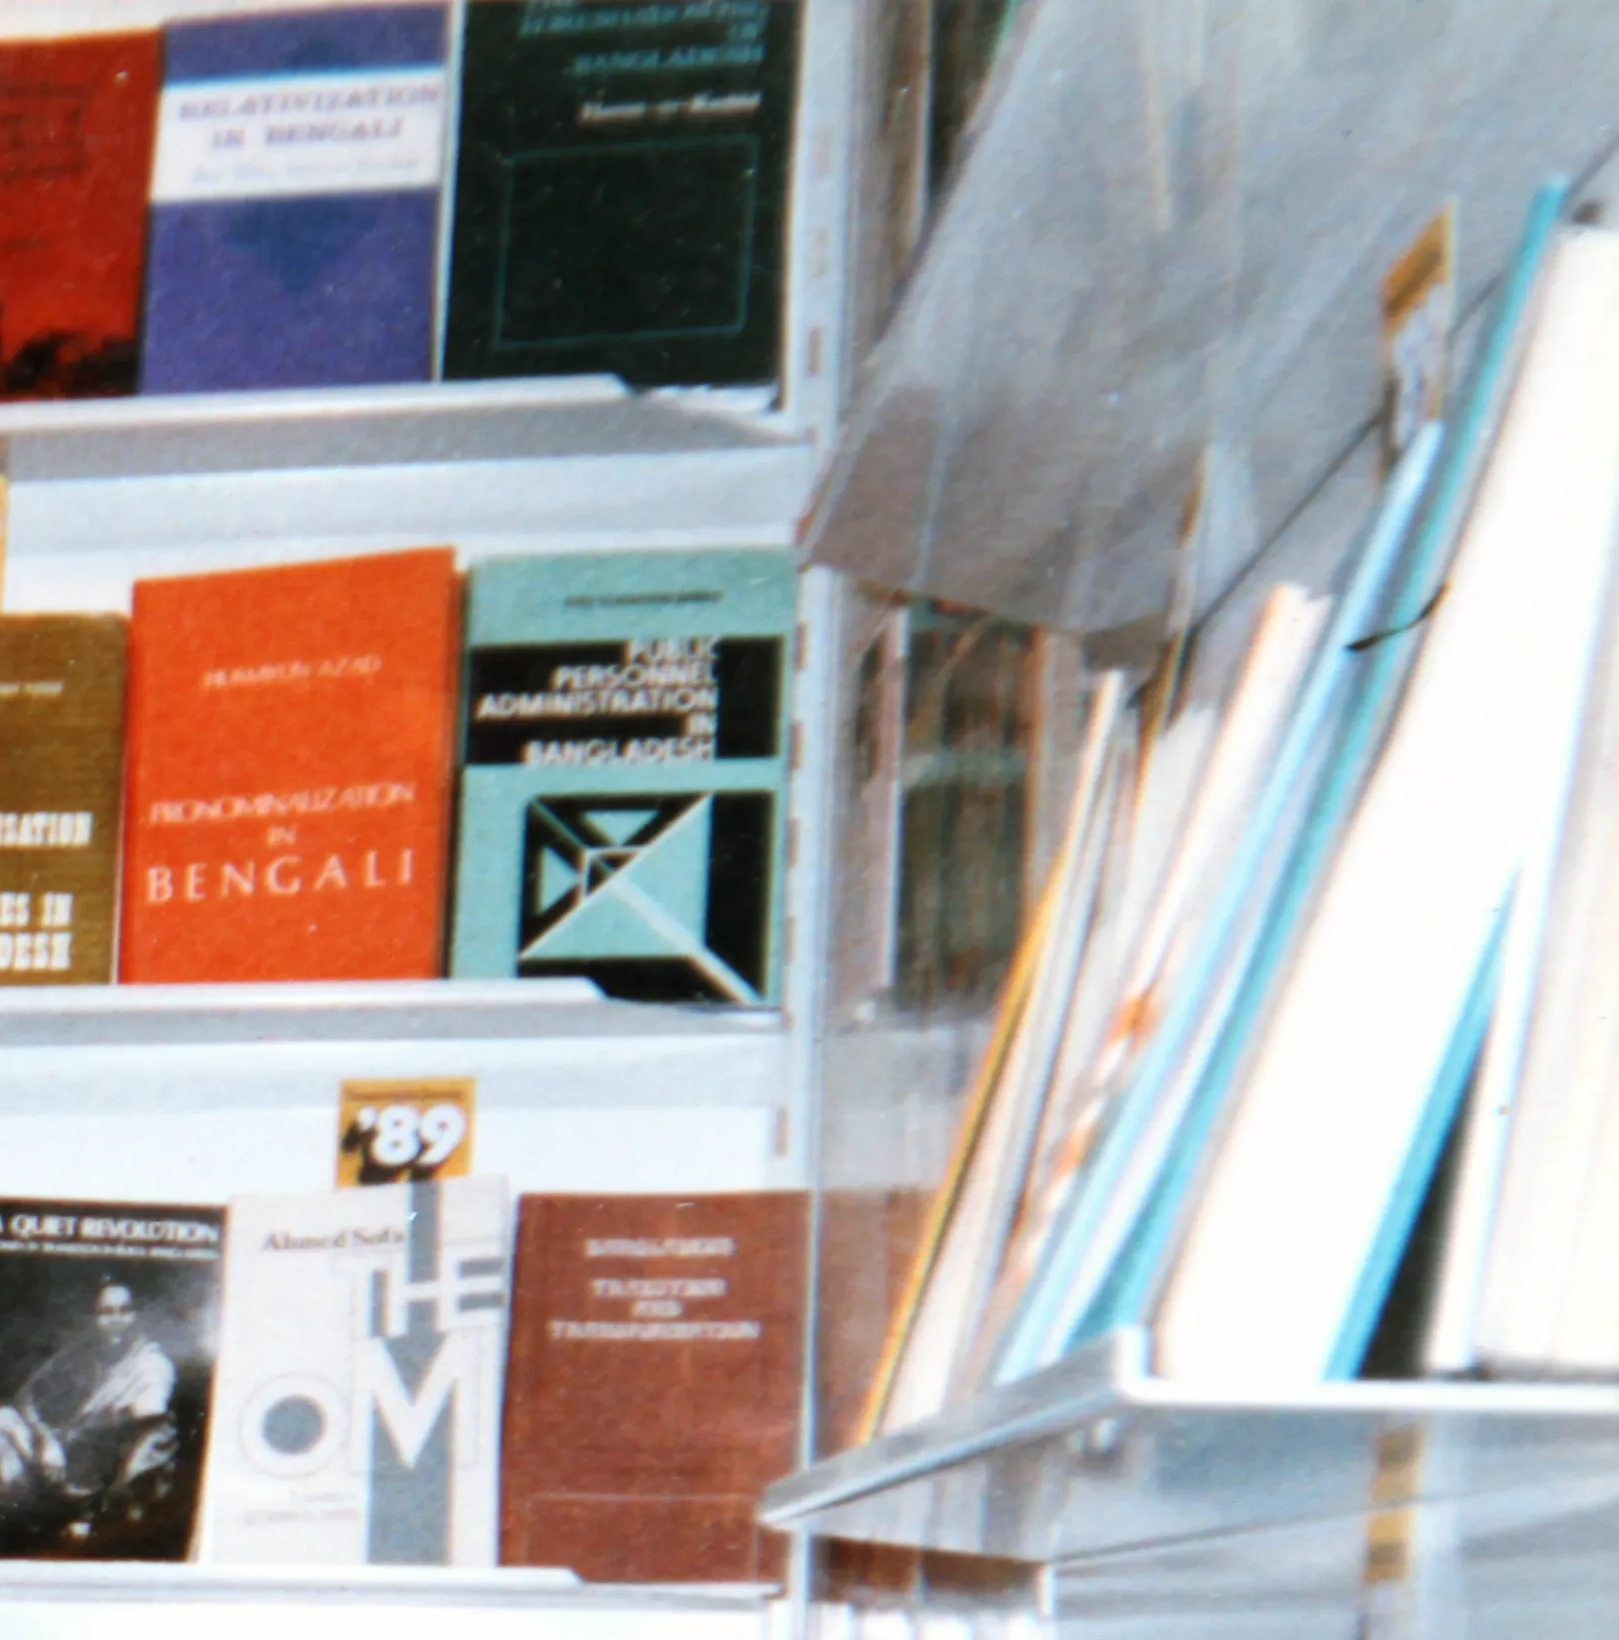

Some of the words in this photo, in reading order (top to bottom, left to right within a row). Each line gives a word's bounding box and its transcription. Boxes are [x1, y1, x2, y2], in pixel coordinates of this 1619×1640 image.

[554, 660, 720, 689] PERSONNEL
[475, 687, 718, 720] ADMINISTRATION
[523, 738, 716, 767] BANGLADESH
[146, 848, 415, 906] BENGALI
[41, 892, 73, 926] IN
[356, 1103, 466, 1165] '89
[12, 1213, 76, 1240] QUIET
[80, 1216, 222, 1245] REVOLUTION
[261, 1230, 348, 1252] Ahmed
